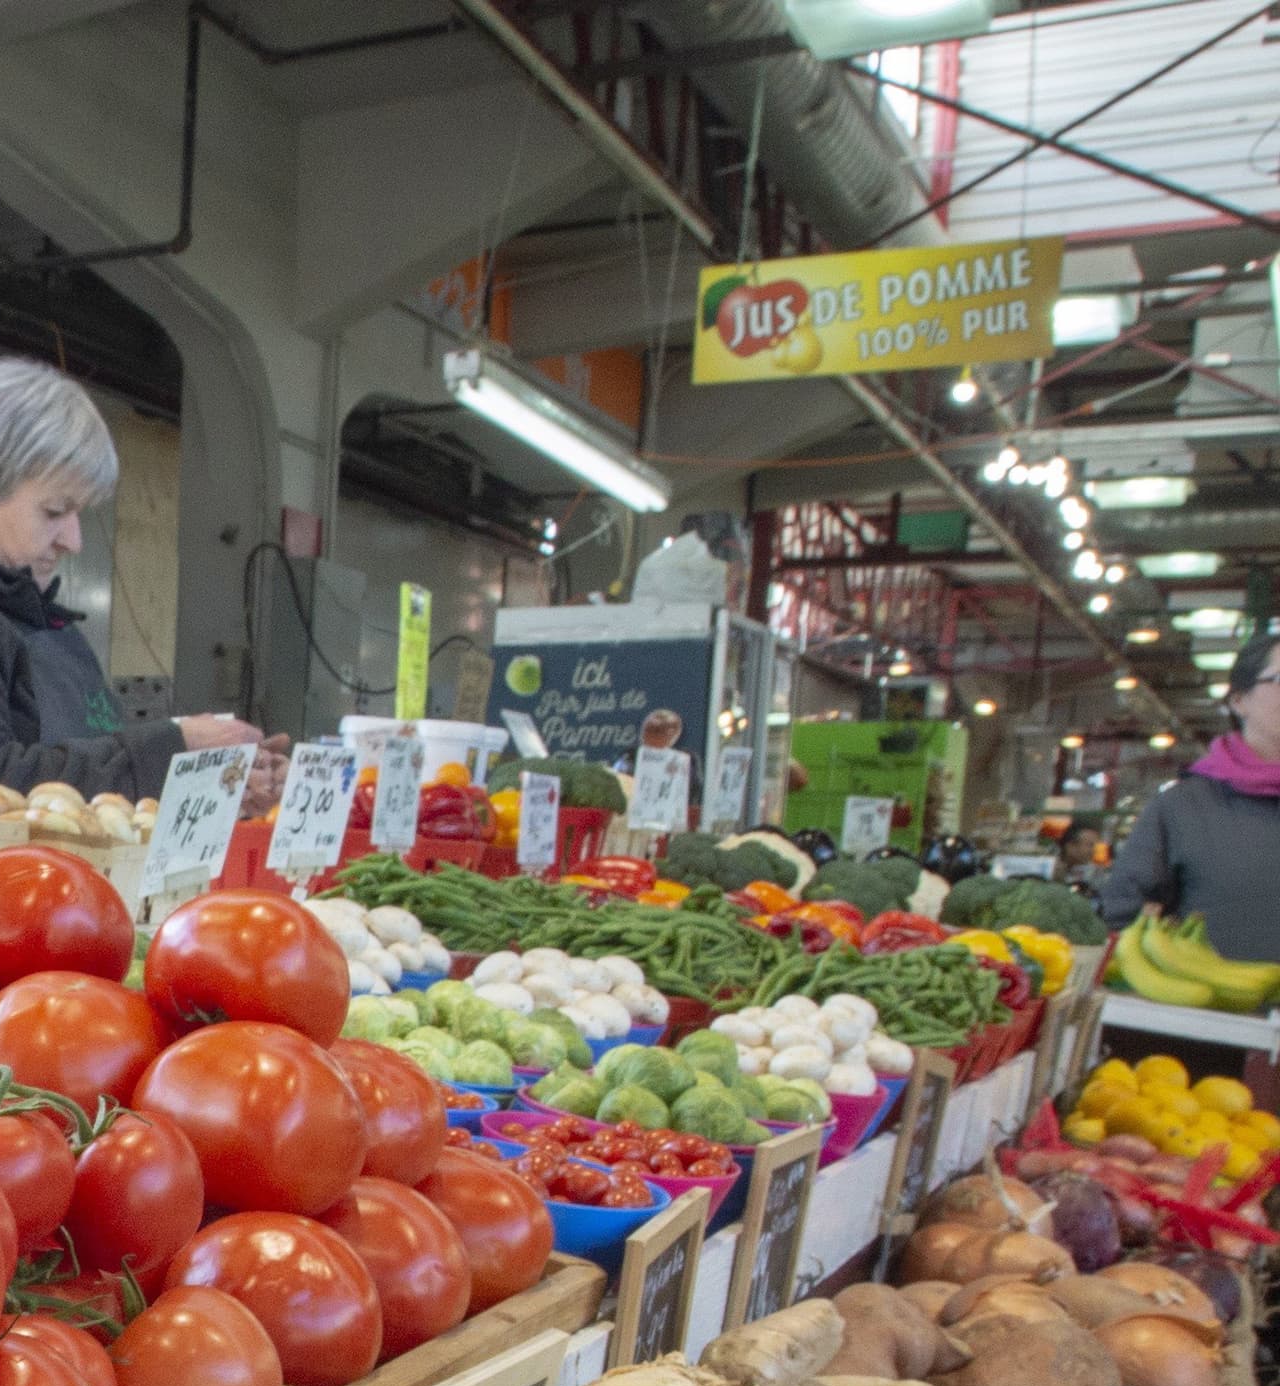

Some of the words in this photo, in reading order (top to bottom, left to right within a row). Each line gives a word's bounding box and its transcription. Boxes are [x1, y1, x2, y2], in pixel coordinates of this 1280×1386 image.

[811, 282, 862, 327] DE
[880, 248, 1032, 314] POMME
[856, 317, 949, 360] 100%
[962, 300, 1029, 341] PUR
